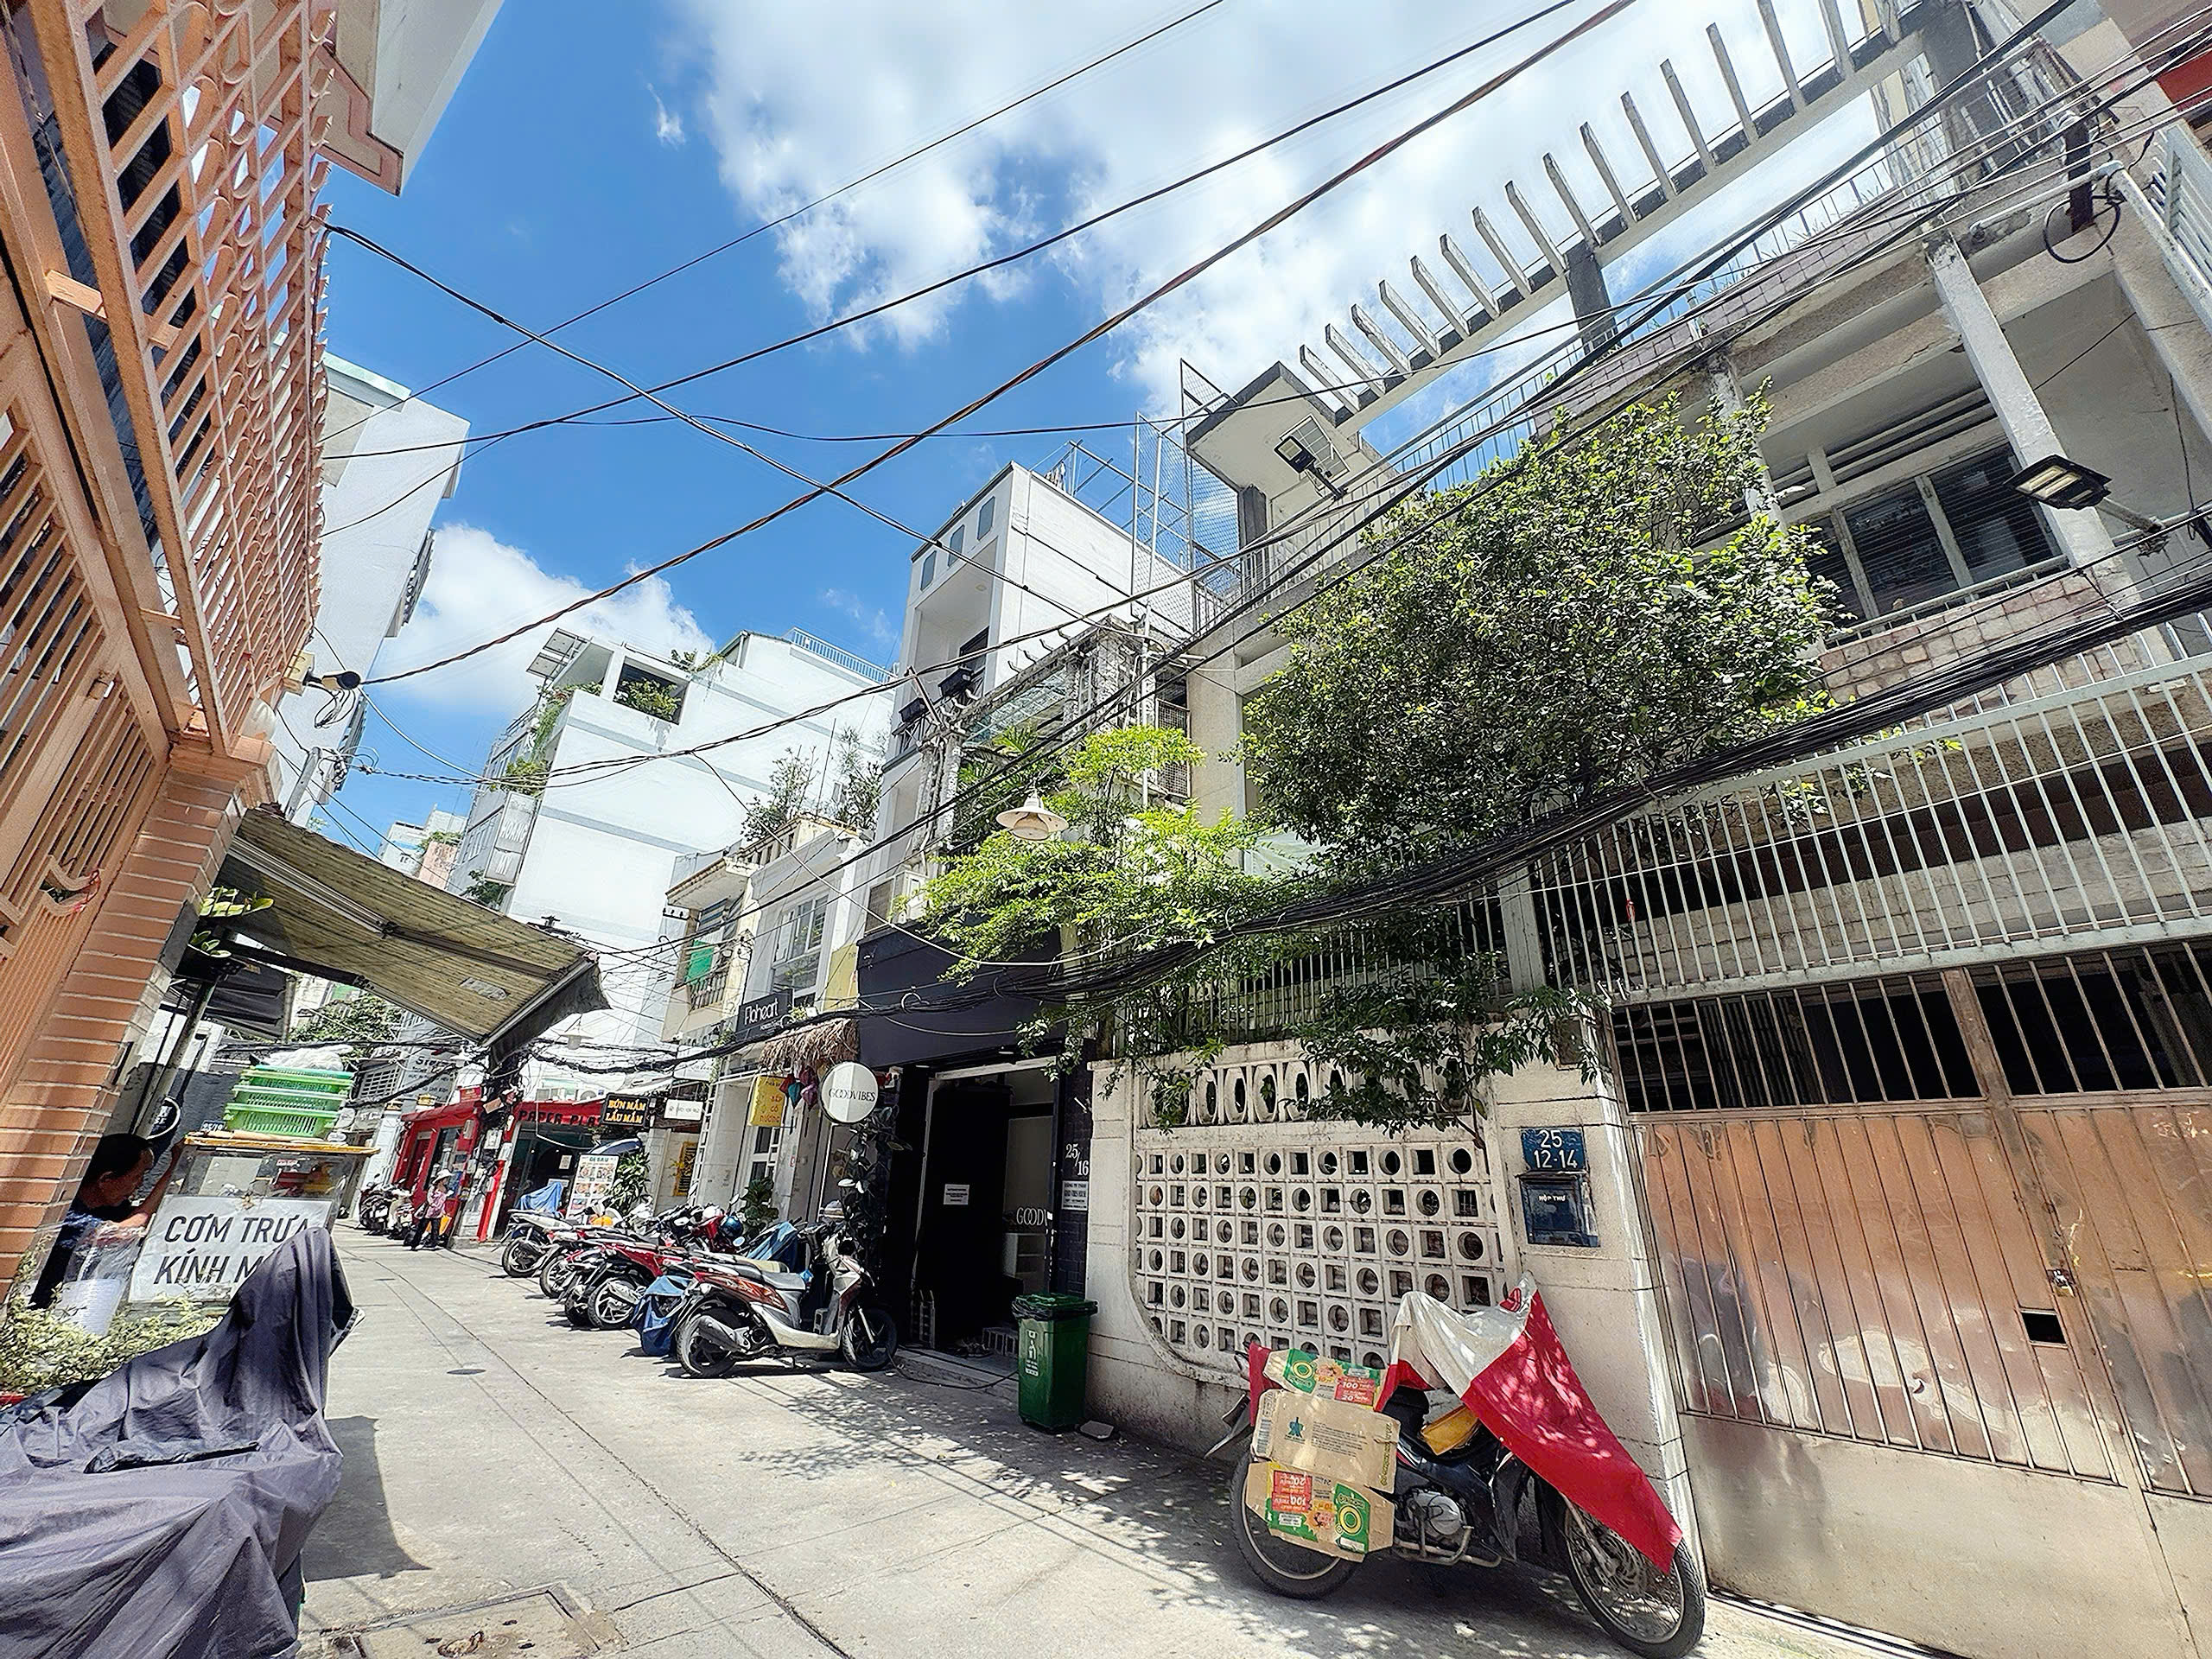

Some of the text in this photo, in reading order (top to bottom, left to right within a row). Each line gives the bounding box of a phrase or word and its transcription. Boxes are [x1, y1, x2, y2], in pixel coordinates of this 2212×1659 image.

[829, 1088, 876, 1103] GOODVIBES
[570, 1115, 603, 1127] PLA
[1540, 1129, 1563, 1148] 25
[1534, 1149, 1578, 1168] 12-14
[164, 1213, 233, 1243] CƠM
[154, 1247, 230, 1285] KÍNH
